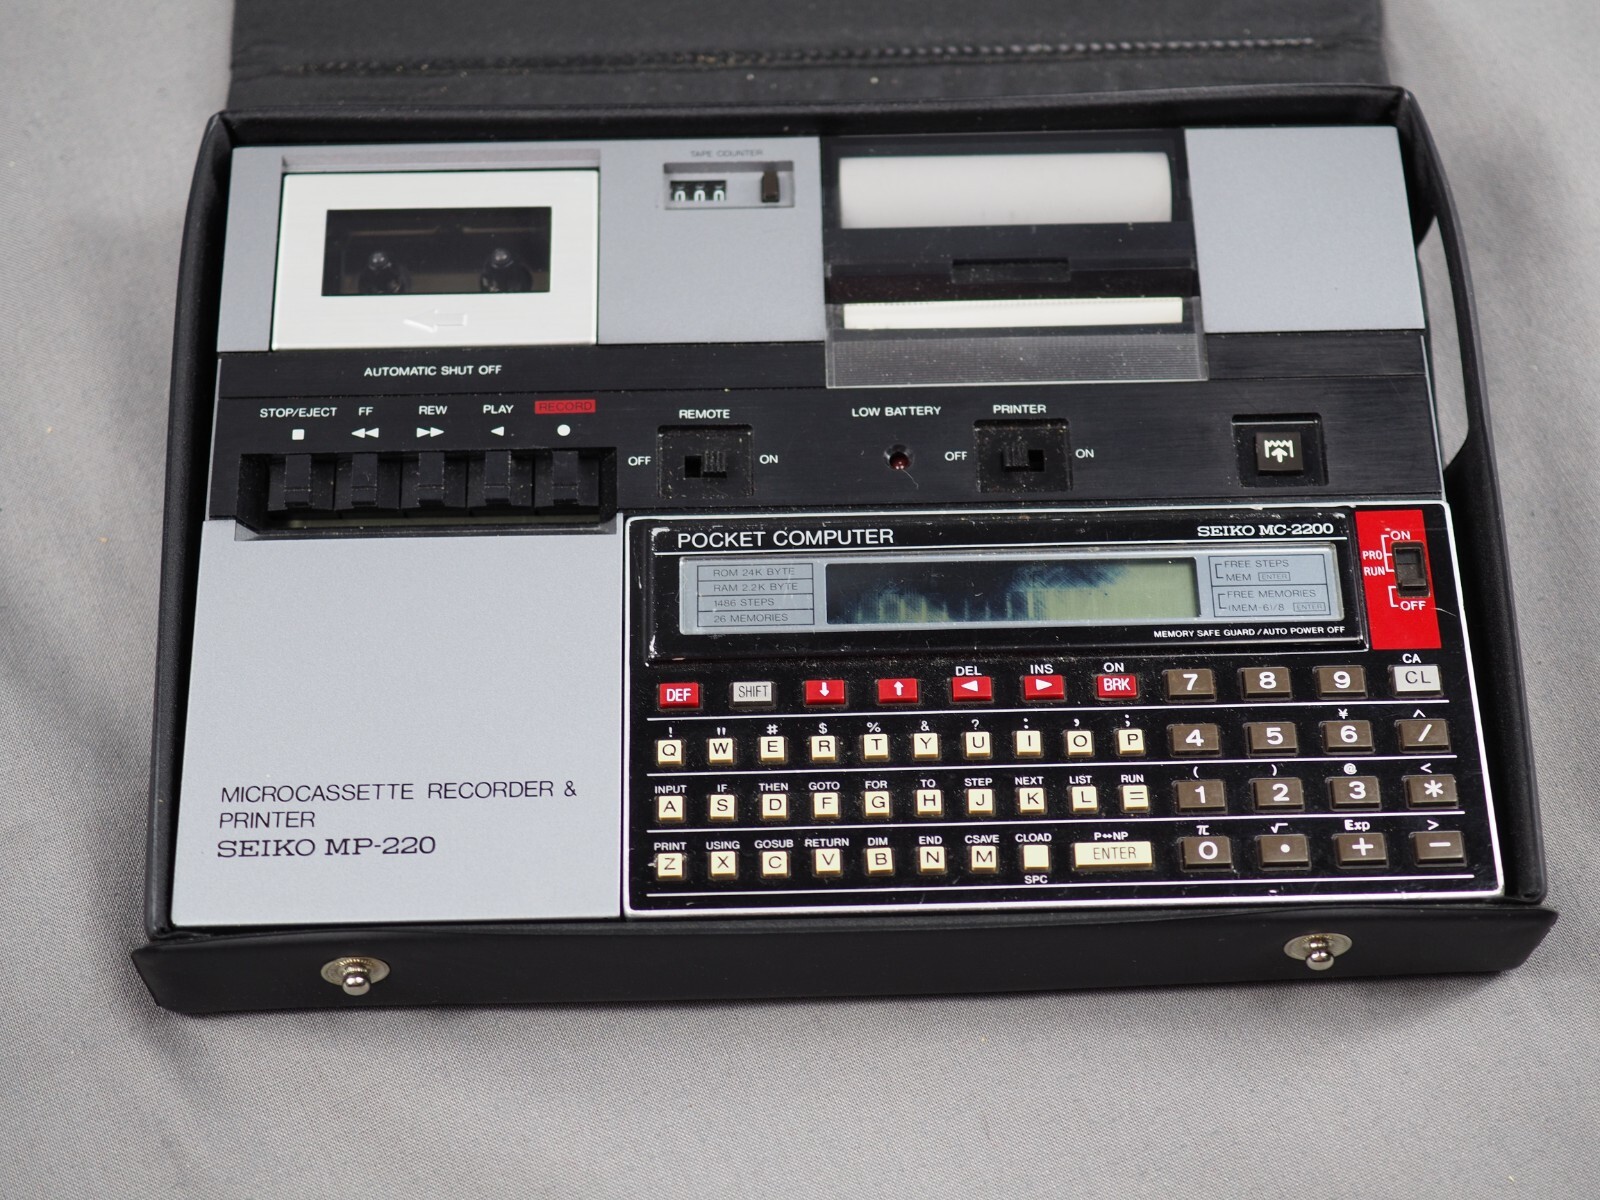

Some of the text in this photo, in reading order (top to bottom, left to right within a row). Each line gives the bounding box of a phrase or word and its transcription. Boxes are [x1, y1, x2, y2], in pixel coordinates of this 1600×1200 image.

[364, 365, 502, 377] AUTOMATIC SHUT OFF
[358, 407, 373, 416] FF
[418, 406, 447, 415] REW
[483, 405, 514, 414] PLAY
[539, 401, 592, 411] RECORD
[852, 406, 941, 417] LOW BATTERY
[993, 404, 1046, 414] PRINTER
[259, 407, 337, 418] STOP/EJECT
[679, 409, 730, 419] REMOTE
[759, 454, 779, 464] ON
[945, 451, 967, 461] OFF
[1075, 449, 1094, 459] ON
[628, 456, 651, 466] OFF
[1197, 523, 1333, 537] SEIKO MC-2200
[1390, 530, 1410, 540] ON
[677, 529, 894, 548] POCKET COMPUTER
[1362, 550, 1382, 560] PRO
[1224, 559, 1289, 568] FREE STEPS
[713, 567, 795, 577] ROM 24K BYTE
[1364, 566, 1385, 576] RUN
[1226, 573, 1252, 582] MEM
[713, 582, 798, 592] RAM 2.2K BYTE
[1227, 589, 1316, 598] FREE MEMORIES
[713, 598, 774, 607] 1486 STEPS
[1295, 603, 1323, 611] ENTER
[1401, 601, 1426, 611] OFF
[713, 613, 788, 622] 26 MEMORIES
[1153, 630, 1194, 638] MEMORY
[1196, 629, 1220, 637] SAFE
[1223, 628, 1255, 637] GUARD
[1290, 627, 1324, 635] POWER
[1327, 626, 1345, 634] OFF
[1402, 654, 1421, 663] CA
[955, 666, 982, 676] DEL
[1030, 664, 1053, 674] INS
[1103, 662, 1124, 672] ON
[1182, 673, 1198, 690] 7
[1259, 671, 1276, 689] 8
[1333, 671, 1351, 688] 9
[1405, 670, 1431, 684] CL
[1103, 678, 1131, 691] BRK
[666, 688, 691, 701] DEF
[738, 685, 768, 698] SHIFT
[767, 724, 778, 734] #
[819, 723, 827, 734] $
[867, 722, 881, 732] %
[921, 721, 930, 731] &
[972, 719, 979, 729] ?
[669, 727, 673, 737] !
[1185, 729, 1204, 746] 4
[1267, 728, 1284, 744] 5
[1340, 726, 1357, 743] 6
[871, 739, 882, 750] T
[920, 738, 932, 749] Y
[973, 737, 984, 748] U
[1073, 735, 1087, 747] O
[1128, 734, 1138, 745] P
[662, 744, 676, 756] Q
[713, 742, 729, 754] W
[767, 741, 777, 752] E
[819, 740, 830, 751] R
[1343, 763, 1357, 775] @
[920, 779, 936, 788] TO
[965, 778, 992, 787] STEP
[1015, 776, 1044, 785] NEXT
[1069, 775, 1092, 784] LIST
[1121, 774, 1144, 783] RUN
[654, 785, 687, 794] INPUT
[717, 784, 727, 792] IF
[759, 783, 788, 791] THEN
[808, 782, 840, 791] GOTO
[865, 781, 887, 789] FOR
[1350, 782, 1366, 799] 3
[221, 781, 577, 803] MICROCASSETTE RECORDER &
[1082, 791, 1091, 803] L
[1195, 786, 1206, 803] 1
[1272, 784, 1289, 801] 2
[770, 798, 782, 810] D
[822, 797, 832, 809] F
[871, 796, 885, 808] G
[924, 795, 936, 806] H
[976, 794, 984, 806] J
[1028, 793, 1039, 804] K
[663, 801, 676, 812] A
[717, 800, 728, 811] S
[219, 811, 315, 828] PRINTER
[1345, 820, 1370, 832] Exp
[805, 838, 849, 847] RETURN
[868, 837, 888, 846] DIM
[919, 836, 942, 844] END
[965, 835, 1000, 843] CSAVE
[1015, 833, 1052, 843] CLOAD
[217, 836, 436, 857] SEIKO MP-220
[654, 842, 687, 851] PRINT
[706, 841, 740, 850] USING
[754, 839, 794, 849] GOSUB
[1094, 847, 1136, 860] ENTER
[1199, 841, 1218, 859] 0
[717, 856, 729, 868] X
[768, 856, 782, 868] C
[822, 854, 834, 865] V
[875, 853, 887, 865] B
[927, 852, 939, 863] N
[976, 851, 993, 862] M
[664, 858, 676, 870] Z
[1024, 875, 1048, 884] SPC
